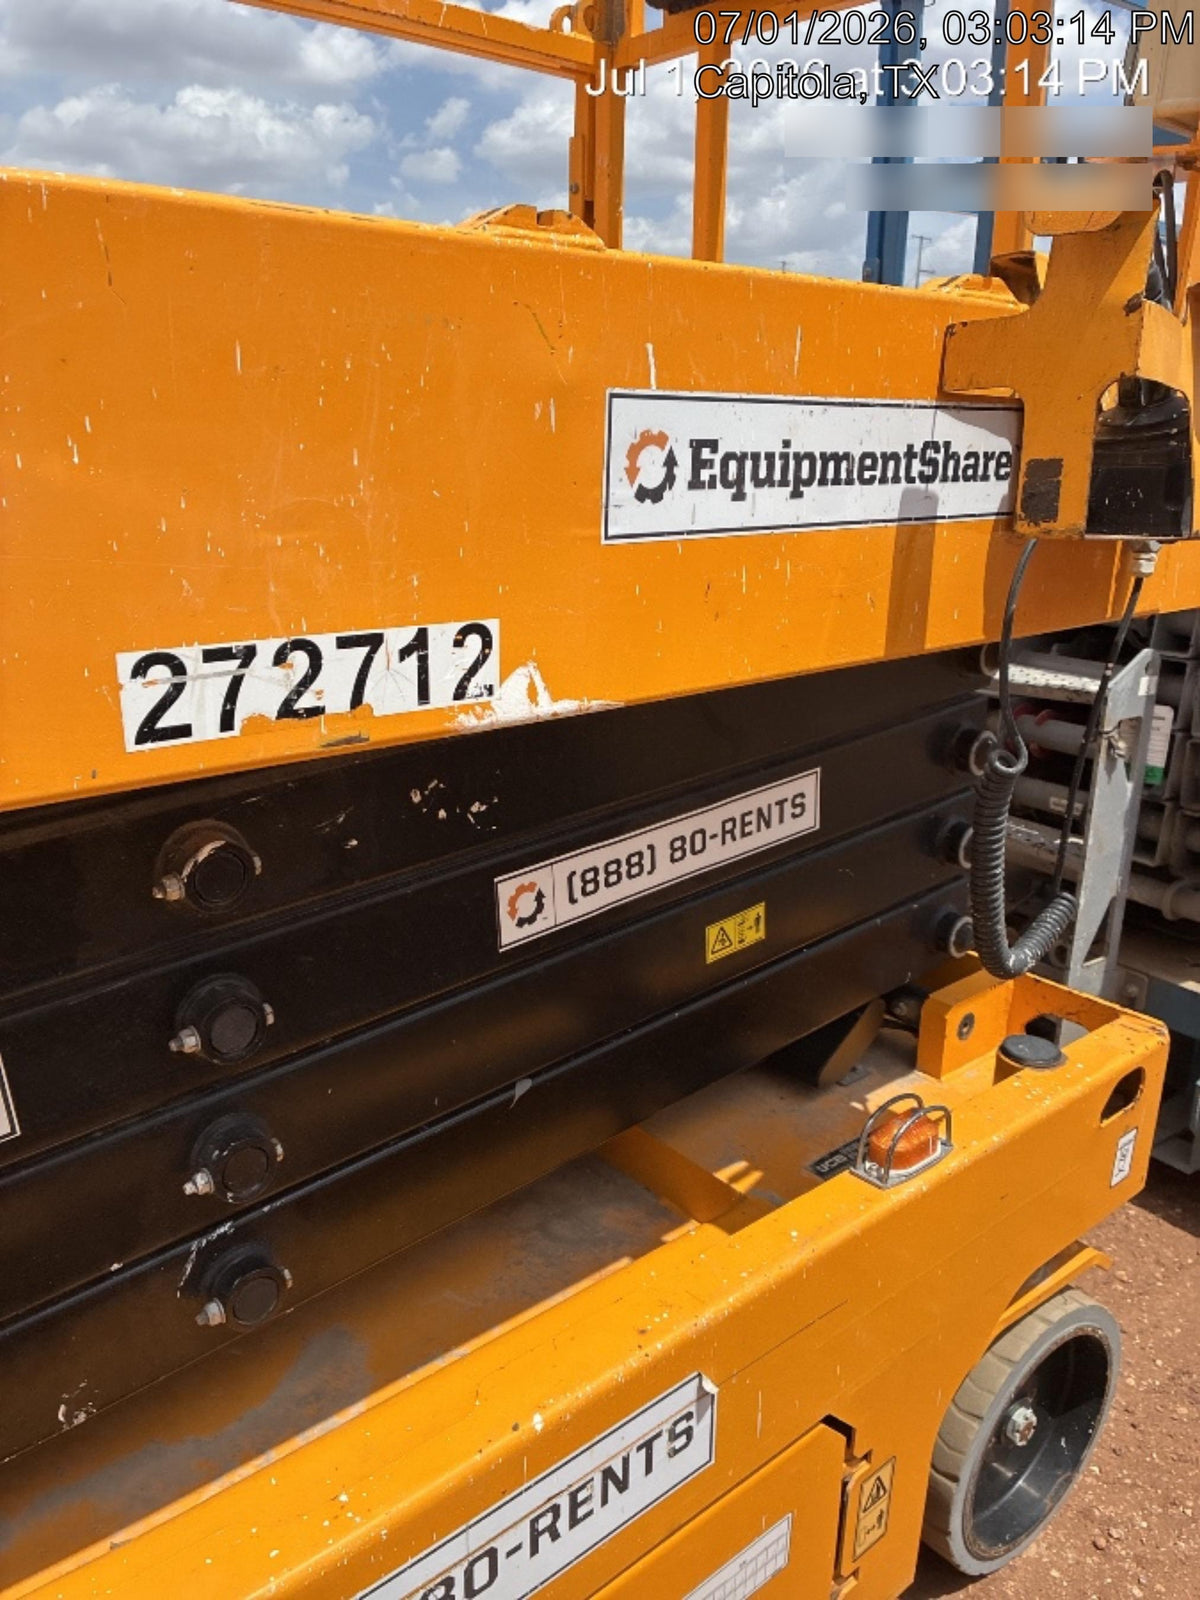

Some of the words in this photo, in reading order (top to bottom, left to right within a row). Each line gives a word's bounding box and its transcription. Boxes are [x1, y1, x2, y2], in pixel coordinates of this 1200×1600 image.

[687, 438, 1012, 501] EquipmentShare
[130, 622, 494, 746] 272712
[566, 844, 656, 905] (888)
[669, 792, 806, 864] 80-RENTS
